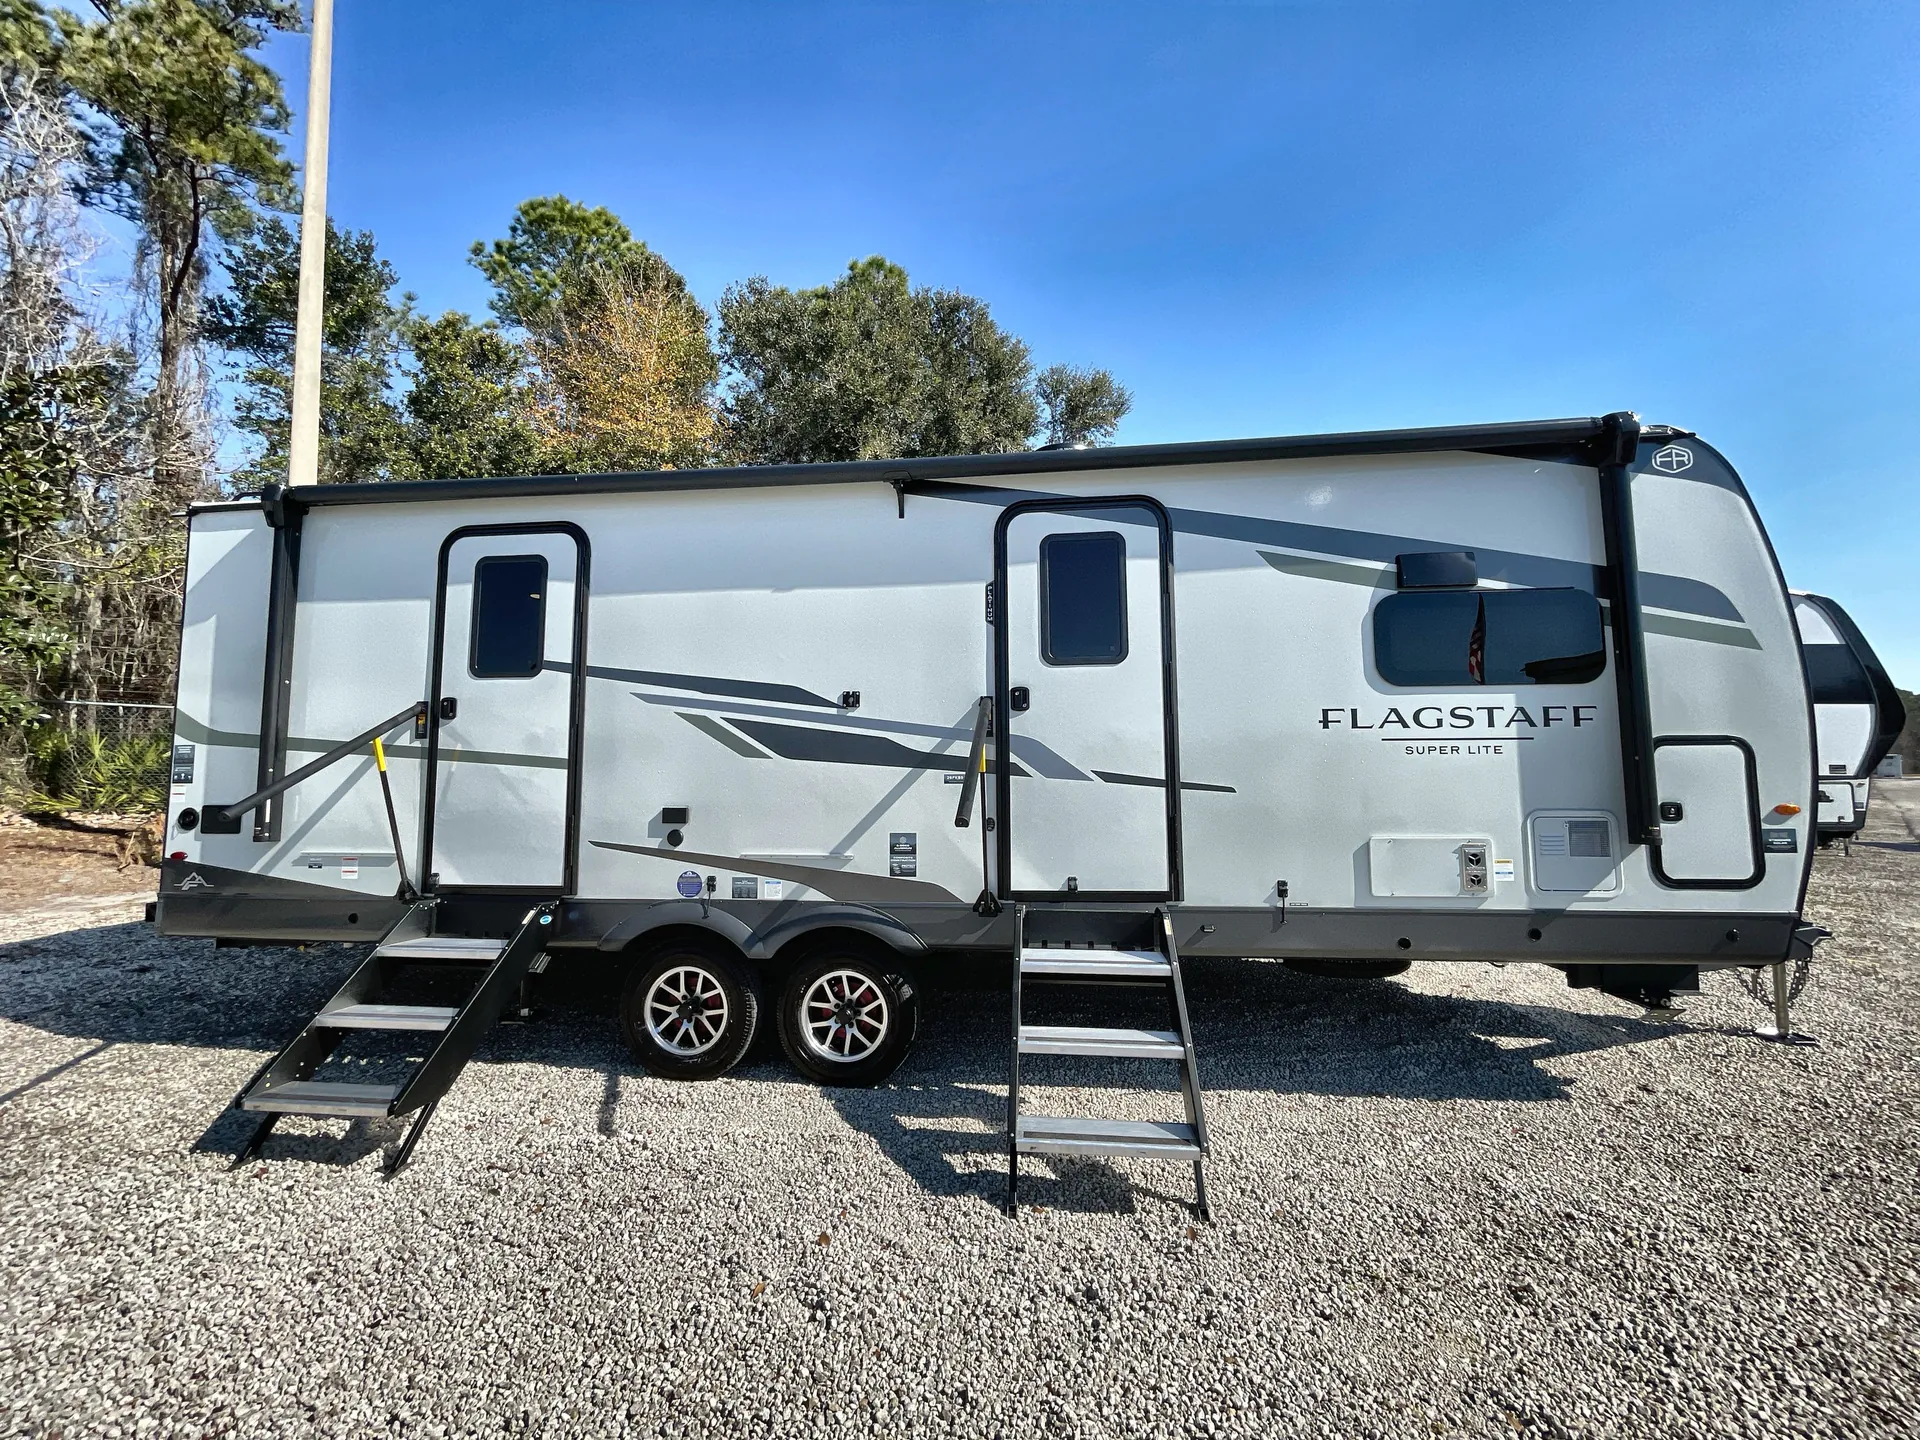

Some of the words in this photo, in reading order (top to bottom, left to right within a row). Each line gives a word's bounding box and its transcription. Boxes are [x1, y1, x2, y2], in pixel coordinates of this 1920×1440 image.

[1655, 447, 1690, 471] FR
[1318, 705, 1598, 730] FLAGSTAFF
[1404, 745, 1461, 756] SUPER
[1467, 744, 1504, 755] LITE
